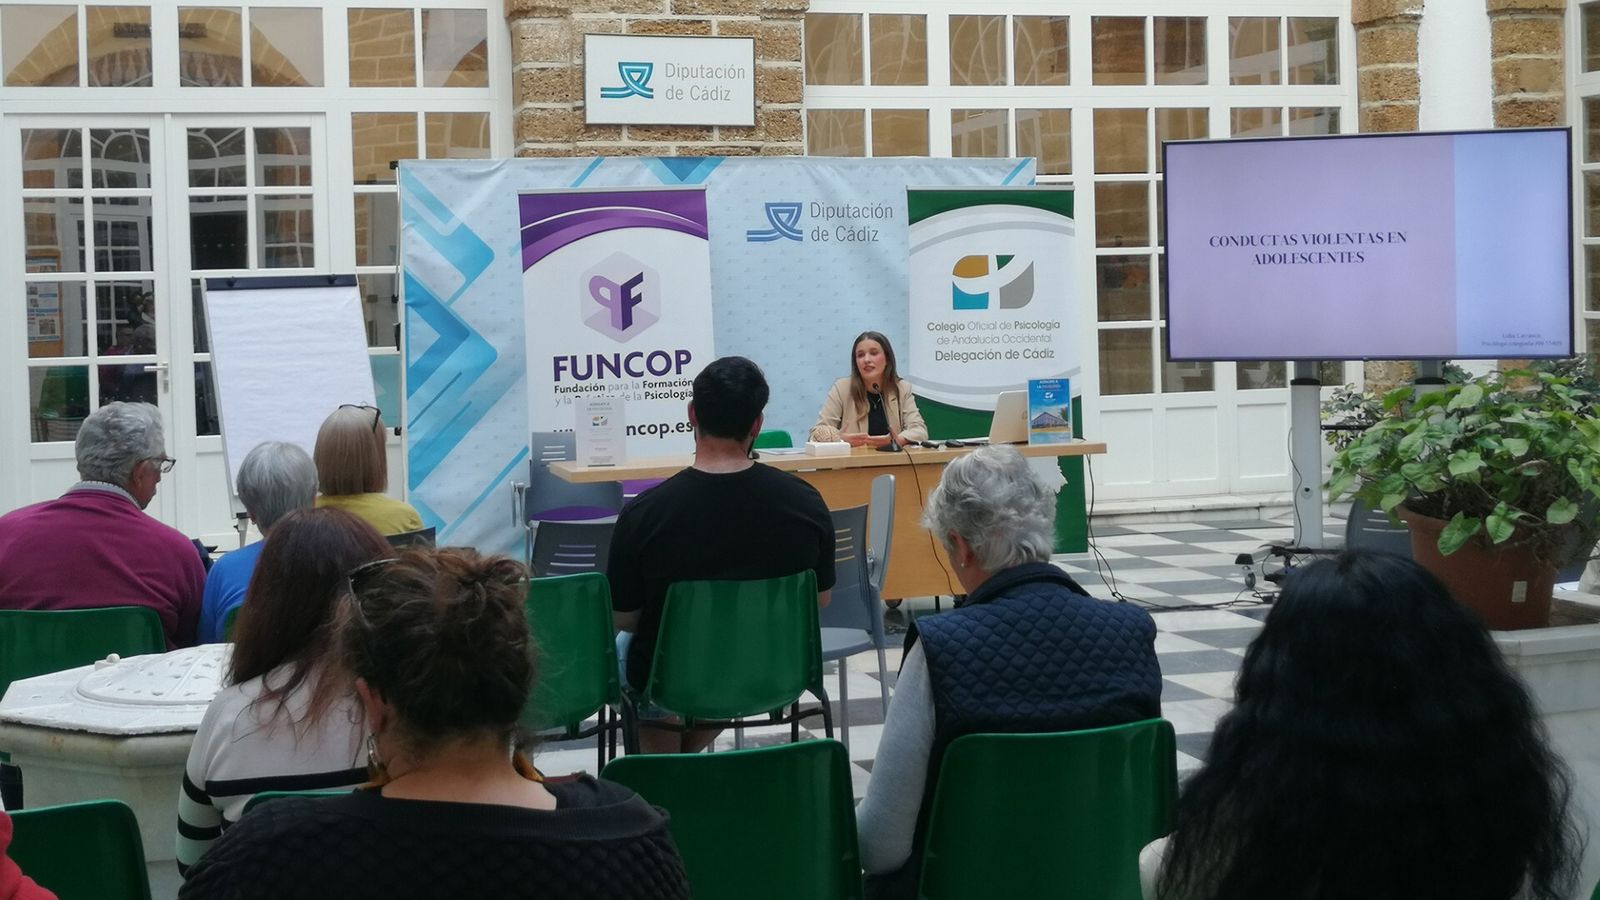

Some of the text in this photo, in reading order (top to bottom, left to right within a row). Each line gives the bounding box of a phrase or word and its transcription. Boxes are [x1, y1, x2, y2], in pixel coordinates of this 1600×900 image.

[665, 62, 745, 80] Diputación
[665, 84, 732, 102] de Cádiz
[810, 201, 894, 220] Diputación
[810, 225, 880, 242] de Cádiz
[1209, 230, 1407, 248] CONDUCTAS VIOLENTAS EN
[1251, 250, 1366, 265] ADOLESCENTES
[926, 321, 966, 333] Colegio
[966, 320, 997, 331] Oficial
[999, 320, 1012, 330] de
[936, 335, 950, 346] de
[1001, 332, 1053, 344] Occidental
[935, 347, 1055, 364] Delegación de Cádiz
[553, 349, 692, 382] FUNCOP
[554, 377, 693, 394] Fundación para la Formación
[554, 398, 561, 408] y
[563, 395, 573, 405] la
[633, 391, 642, 401] la
[644, 389, 693, 401] Psicología
